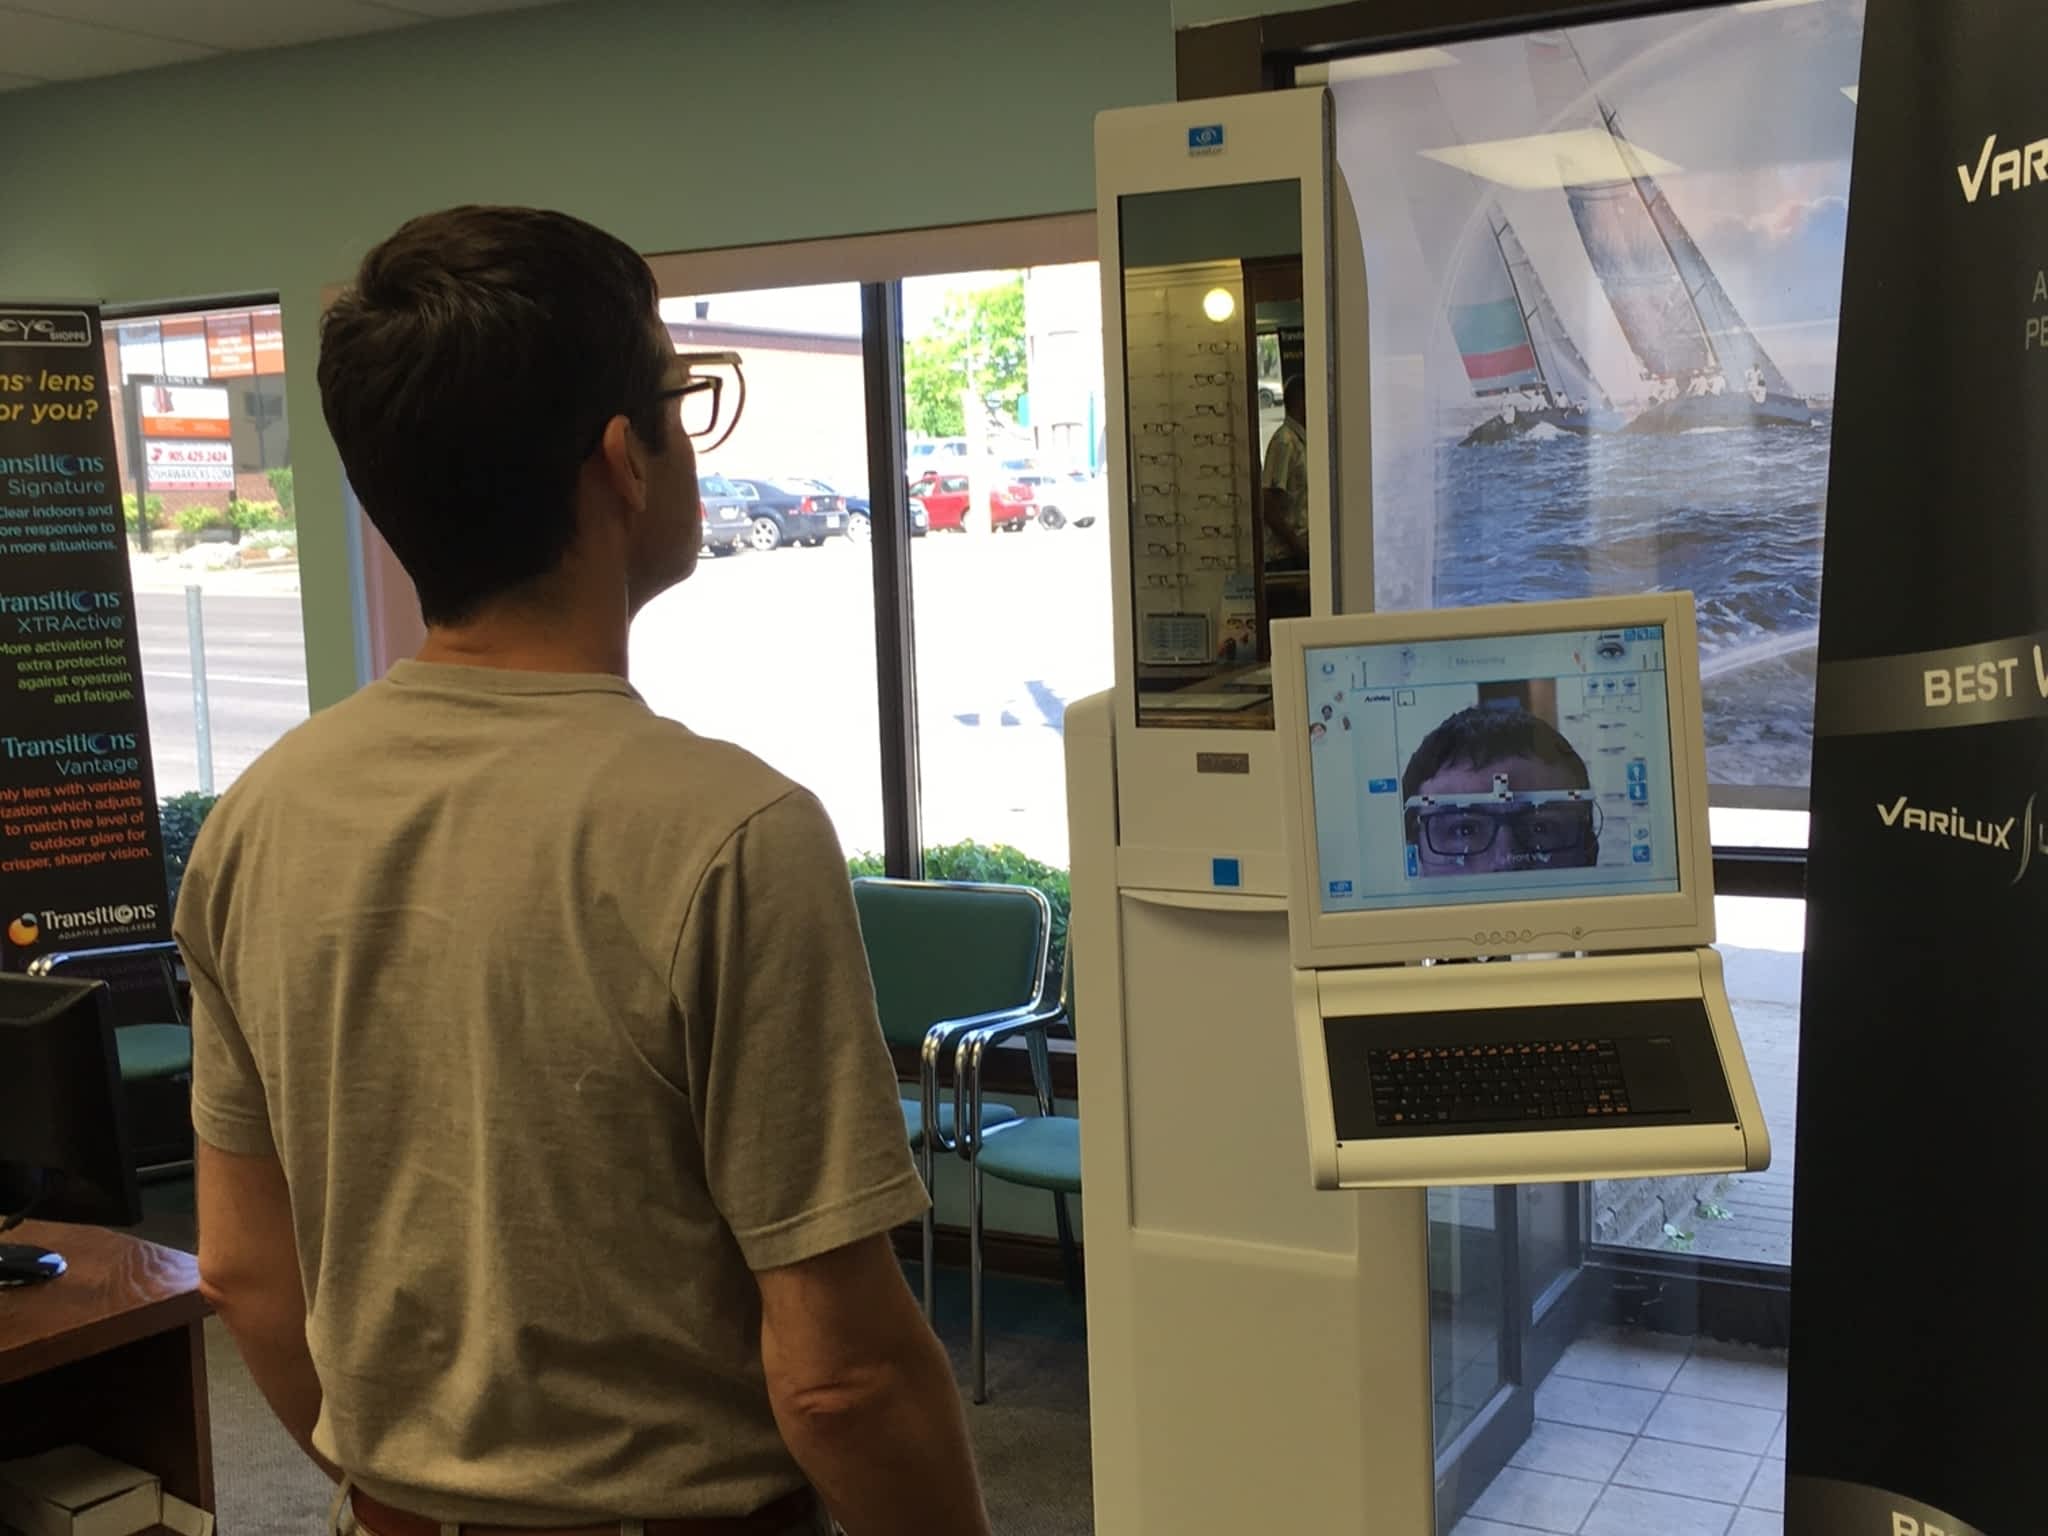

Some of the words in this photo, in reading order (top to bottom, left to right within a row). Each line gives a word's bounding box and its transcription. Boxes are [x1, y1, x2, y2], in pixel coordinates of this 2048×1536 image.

[39, 369, 95, 392] lens
[31, 399, 98, 424] you?
[8, 479, 104, 498] Signature
[32, 504, 84, 518] indoors
[87, 503, 113, 516] and
[25, 523, 97, 536] responsive
[100, 520, 116, 534] to
[10, 542, 46, 554] more
[0, 589, 120, 613] ransitions
[35, 637, 101, 653] activation
[105, 637, 124, 649] for
[17, 659, 52, 672] extra
[55, 654, 127, 672] protection
[18, 675, 68, 690] against
[71, 671, 132, 687] eyestrain
[1923, 657, 2018, 707] BEST
[54, 691, 81, 704] and
[1, 732, 137, 759] Transitions
[56, 757, 138, 777] Vantage
[23, 786, 50, 799] lens
[54, 782, 84, 797] with
[87, 778, 141, 793] variable
[51, 799, 91, 815] which
[95, 795, 143, 811] adjusts
[4, 824, 20, 837] to
[23, 818, 68, 834] match
[71, 816, 94, 830] the
[96, 812, 127, 827] level
[130, 811, 144, 823] of
[30, 835, 85, 851] outdoor
[90, 831, 124, 847] glare
[127, 828, 147, 842] for
[55, 850, 107, 867] sharper
[40, 903, 157, 930] Transitions
